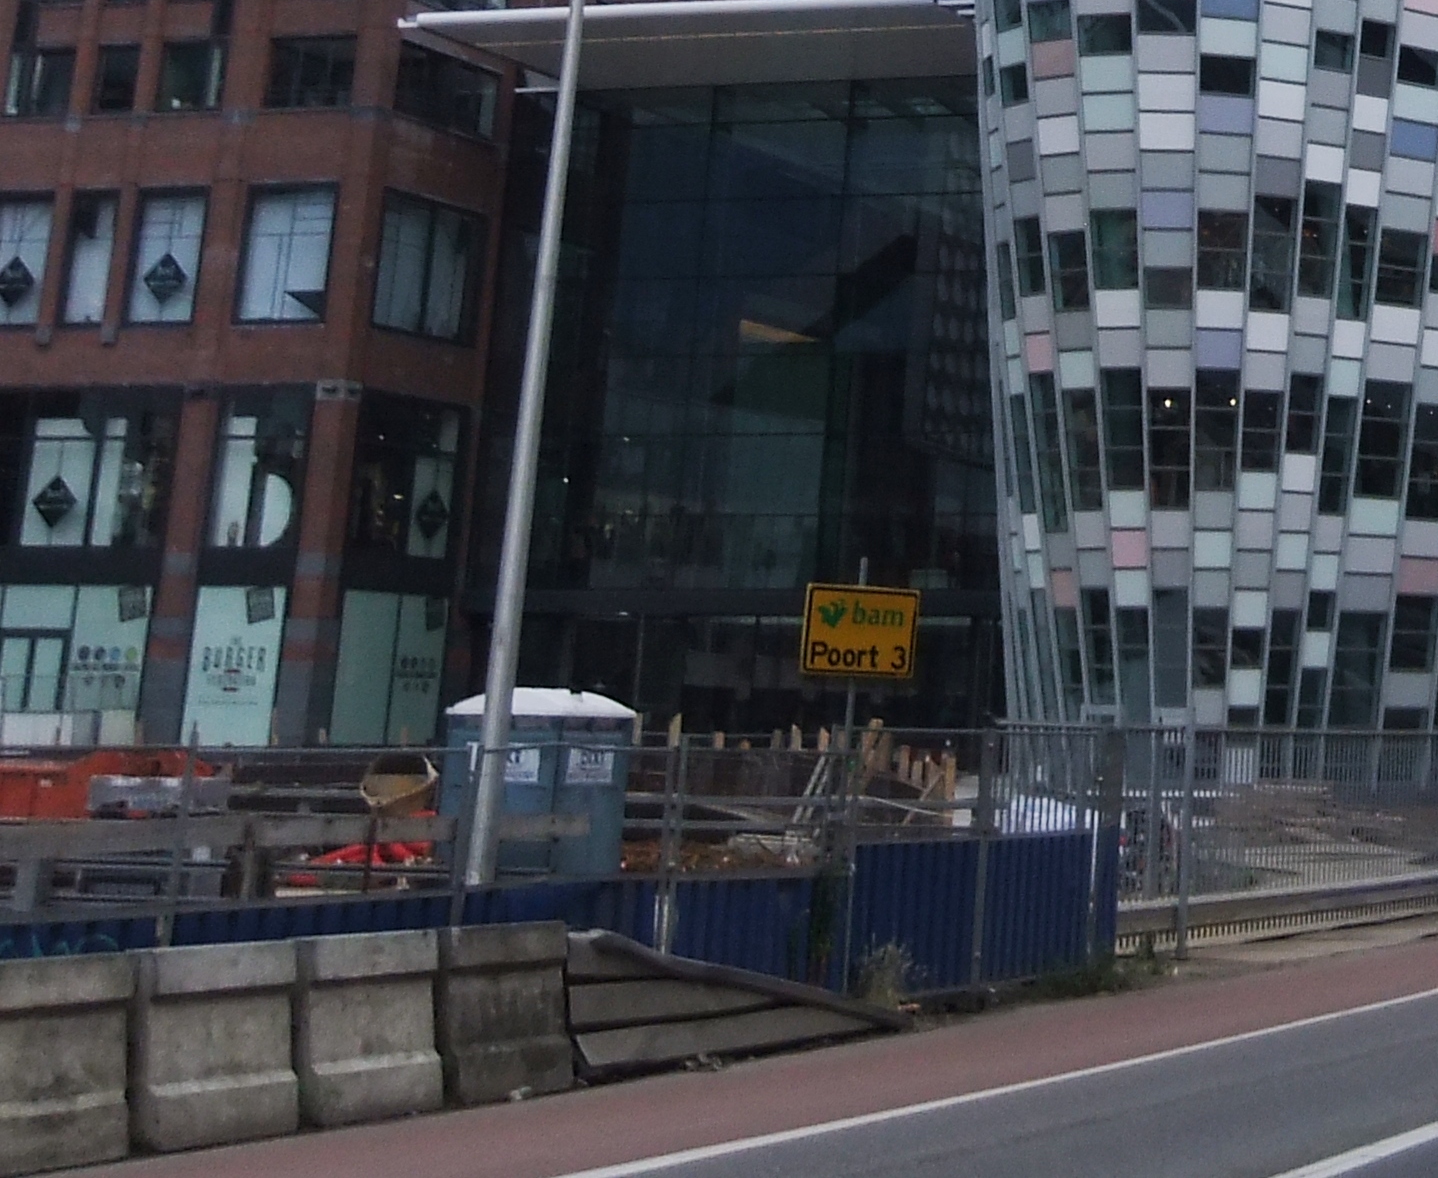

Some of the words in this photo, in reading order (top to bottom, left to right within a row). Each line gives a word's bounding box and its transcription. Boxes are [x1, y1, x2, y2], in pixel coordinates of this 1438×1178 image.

[852, 600, 904, 626] bam
[202, 646, 266, 672] BURGER
[811, 641, 878, 668] Poort
[891, 646, 906, 669] 3
